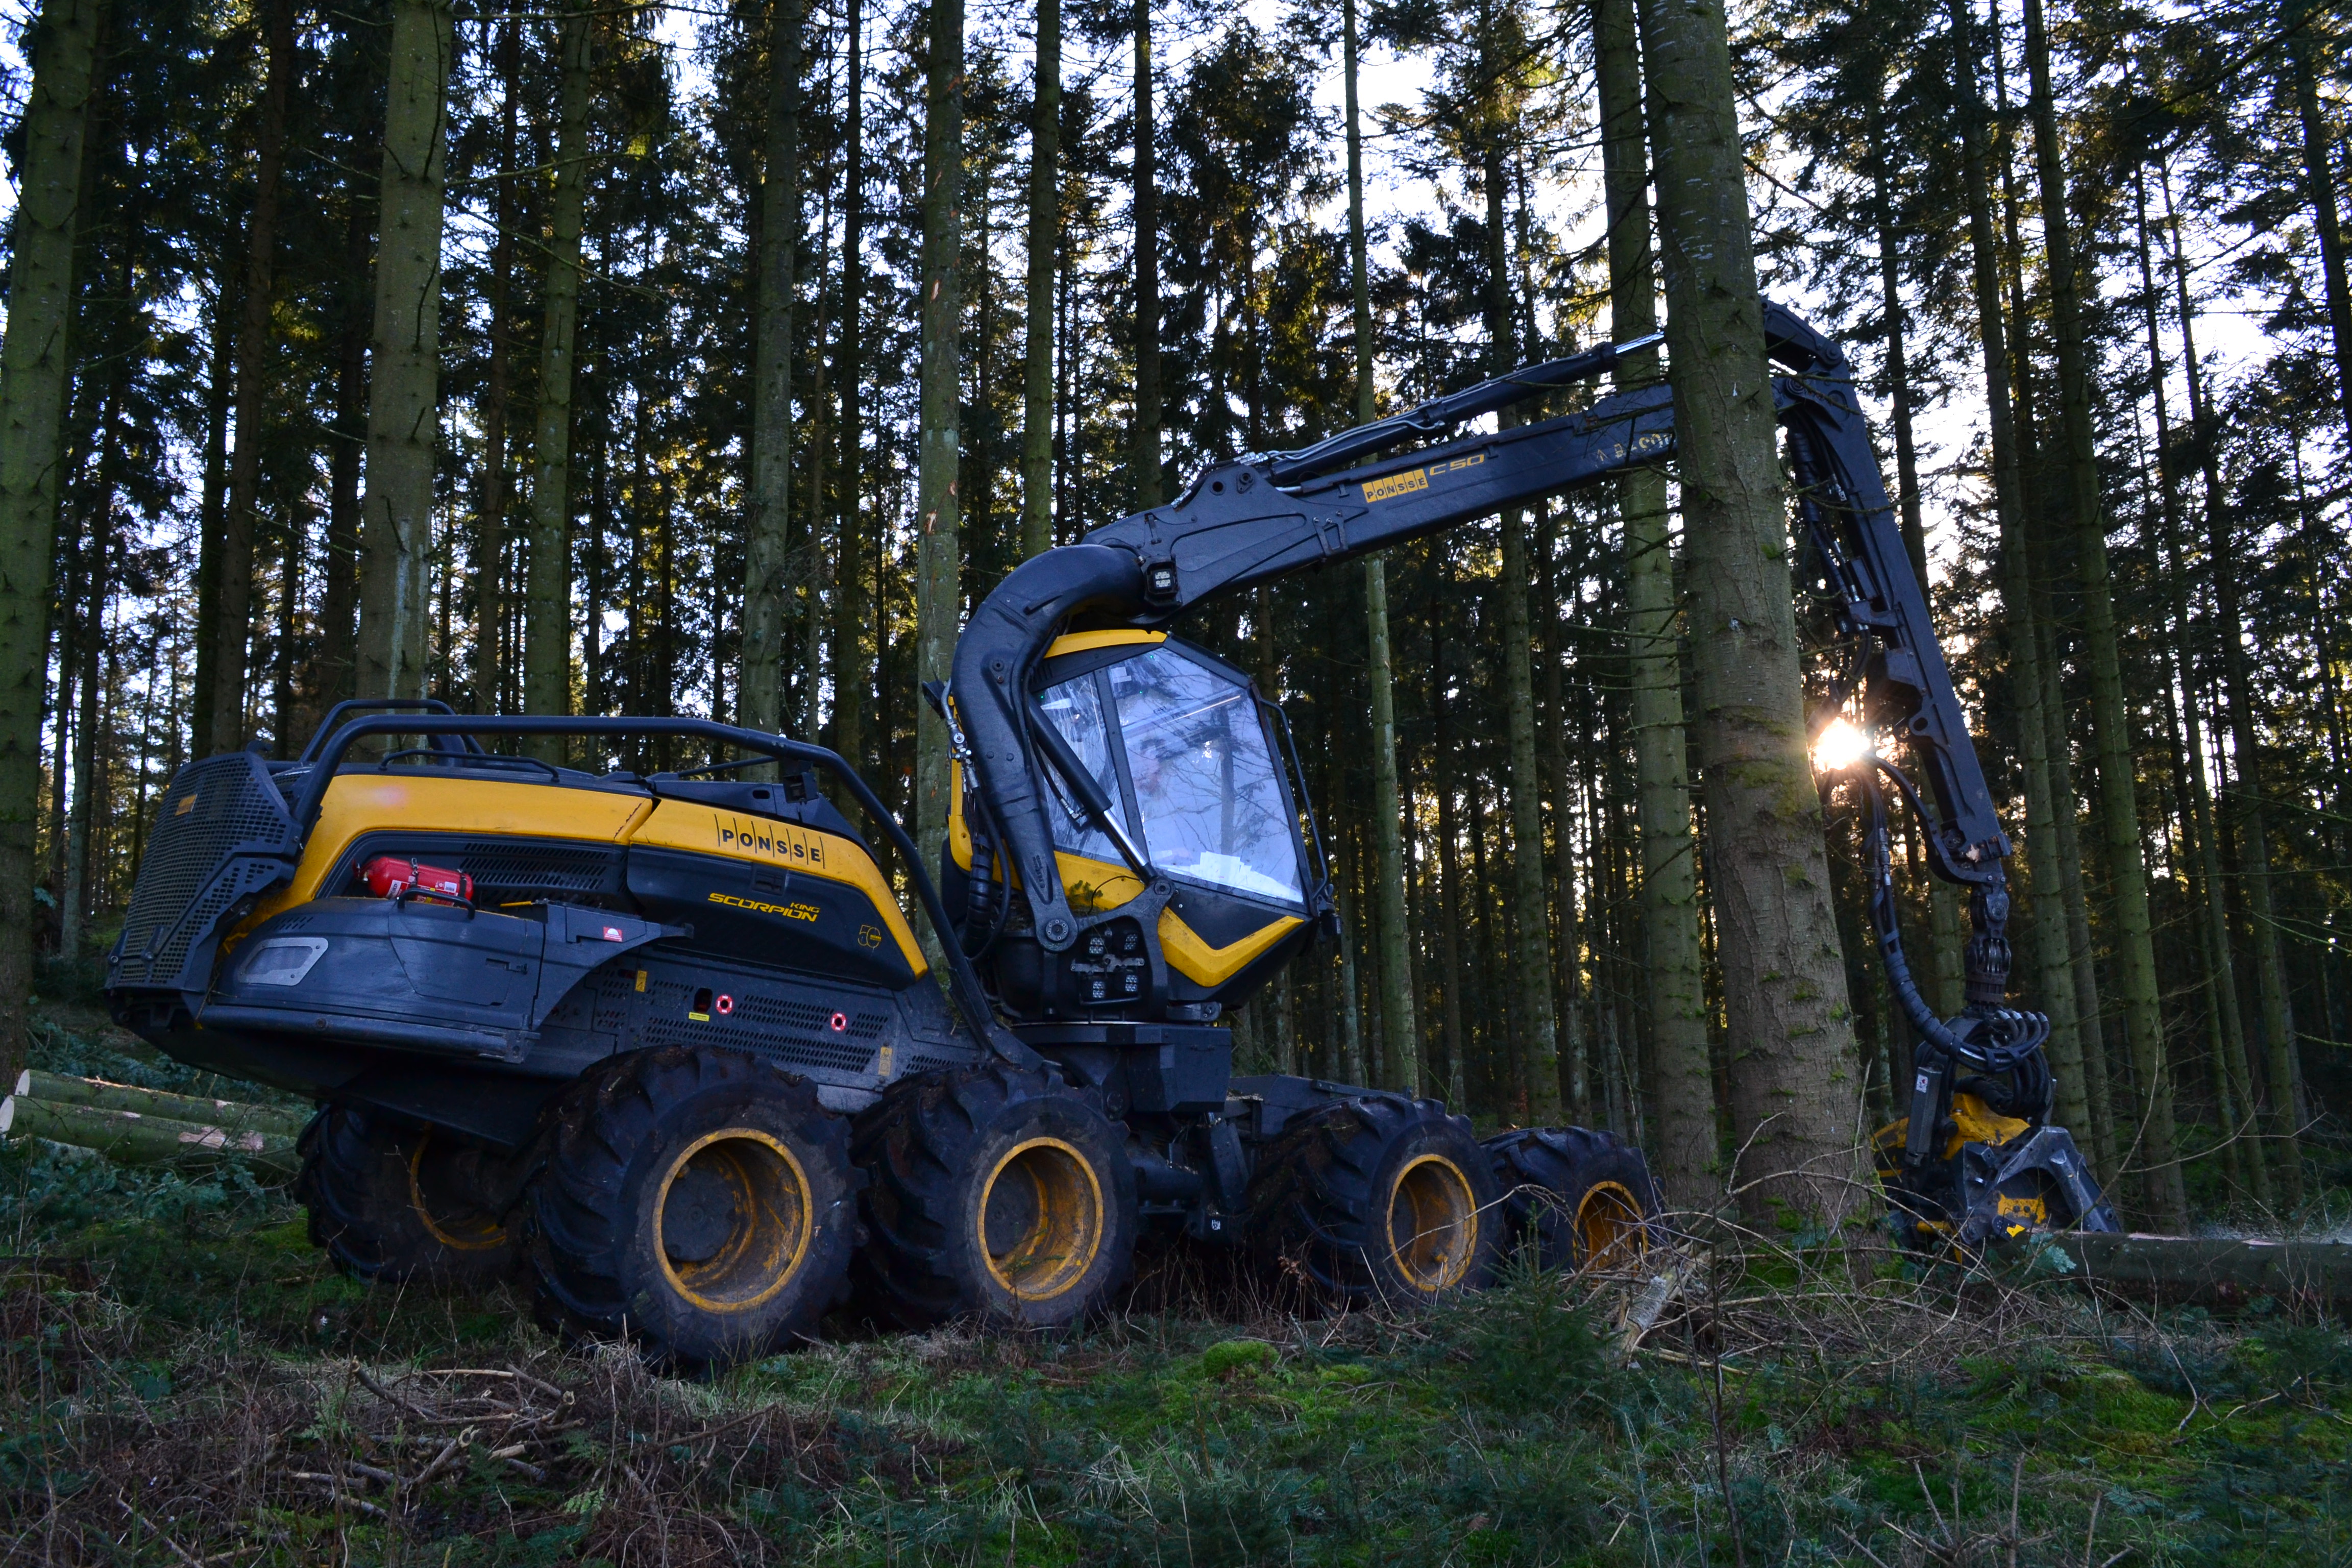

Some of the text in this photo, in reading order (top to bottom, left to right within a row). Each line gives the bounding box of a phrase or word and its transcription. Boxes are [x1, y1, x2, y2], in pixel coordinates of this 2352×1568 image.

[1366, 477, 1426, 500] PONSSE
[722, 828, 821, 863] PONSSE
[707, 893, 818, 922] SCORPION
[790, 902, 820, 913] KING
